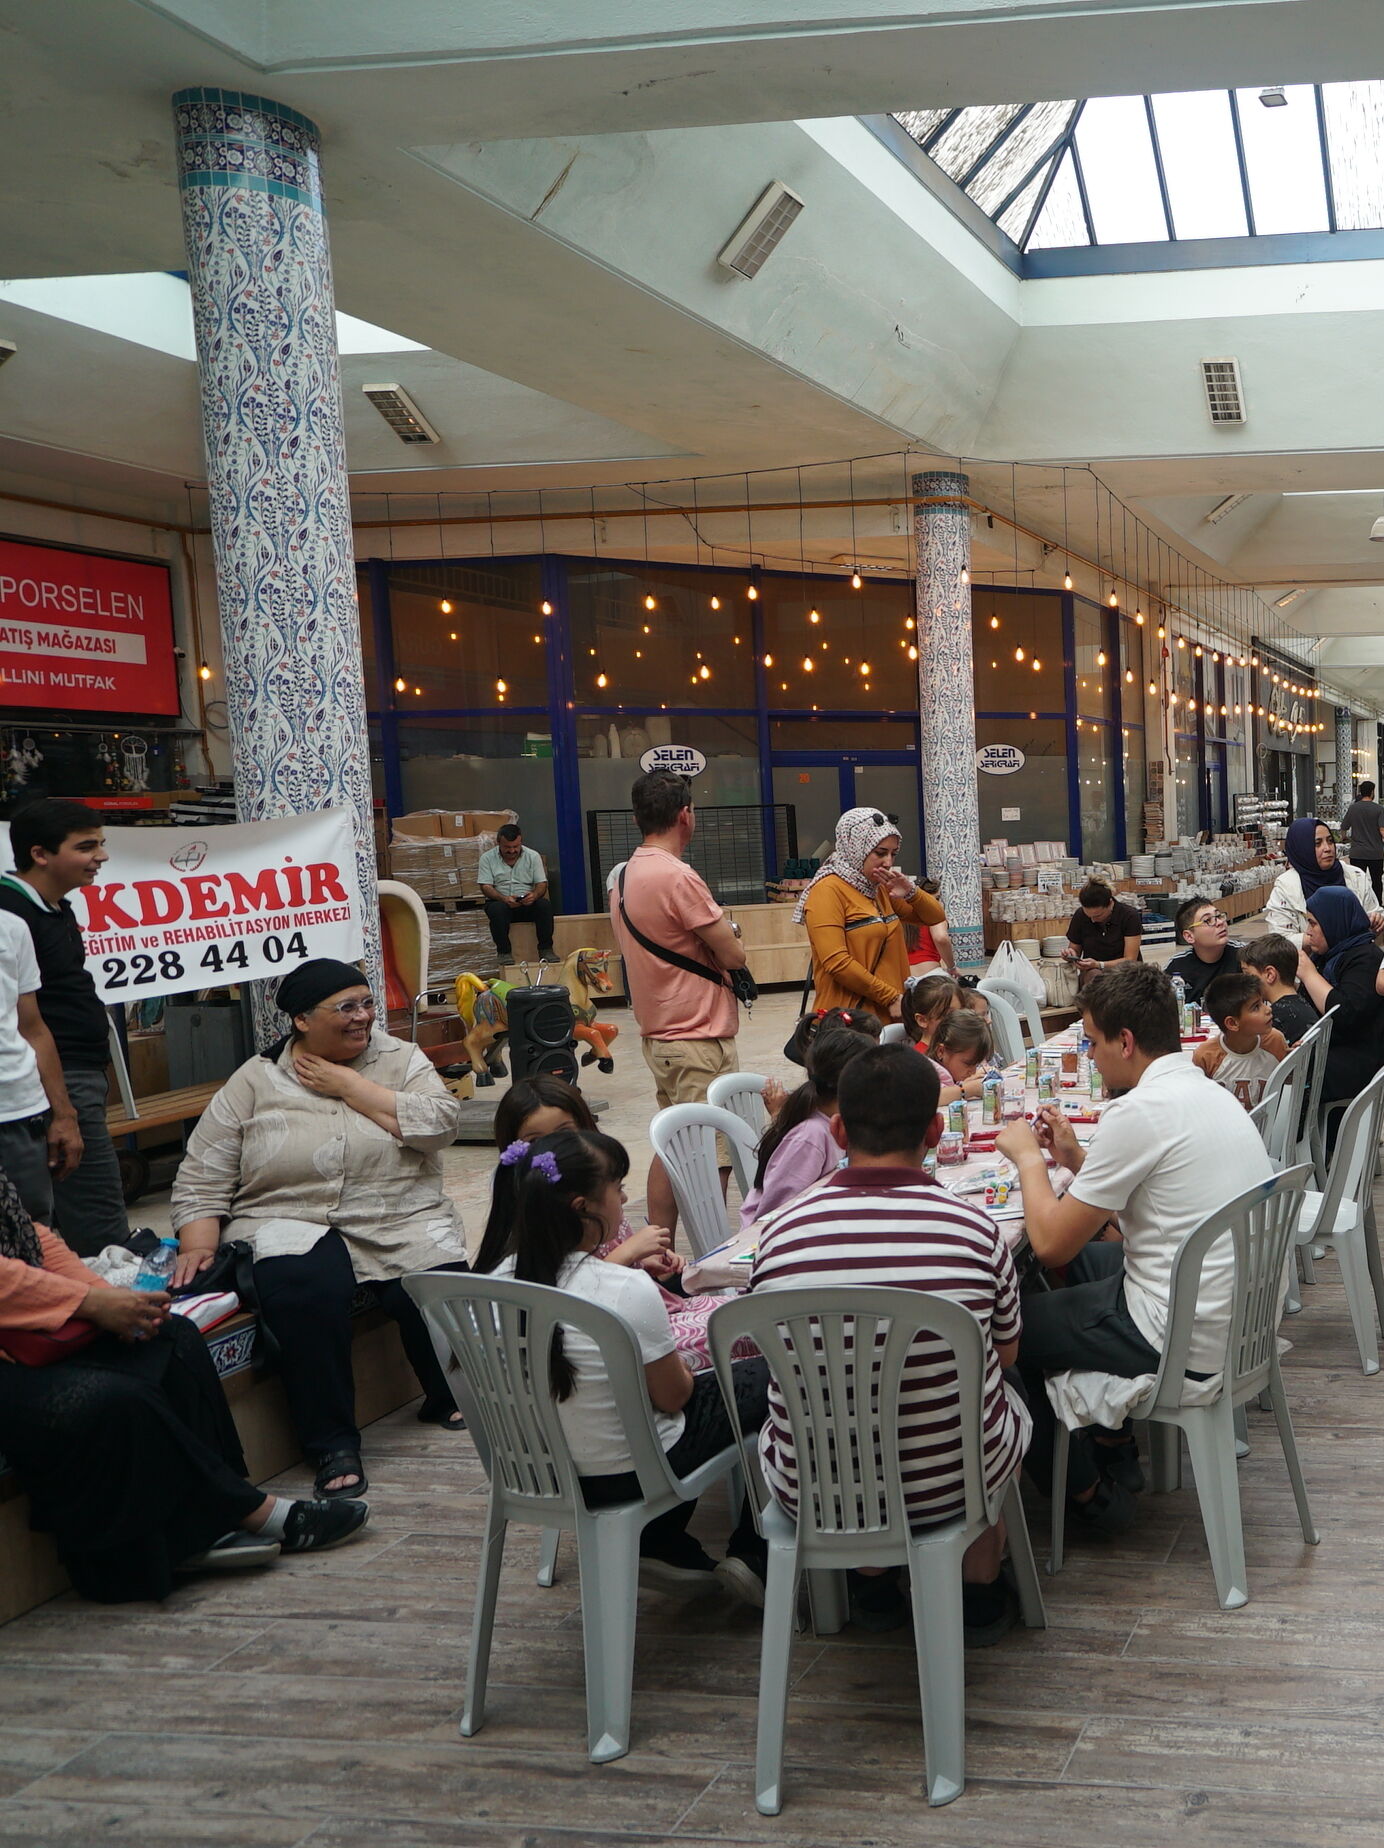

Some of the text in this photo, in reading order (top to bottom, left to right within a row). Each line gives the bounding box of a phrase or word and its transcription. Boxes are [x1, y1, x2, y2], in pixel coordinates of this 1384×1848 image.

[0, 575, 144, 621] PORSELEN
[37, 630, 116, 654] MAĞAZASI
[49, 671, 117, 691] MUTFAK
[653, 749, 694, 761] SELEN
[983, 748, 1016, 758] SELEN
[76, 856, 349, 933] KDEMİR
[140, 936, 160, 949] ve
[163, 914, 290, 946] REHABİLİTASYON
[293, 902, 351, 930] MERKEZİ
[102, 931, 309, 989] 228 44 04
